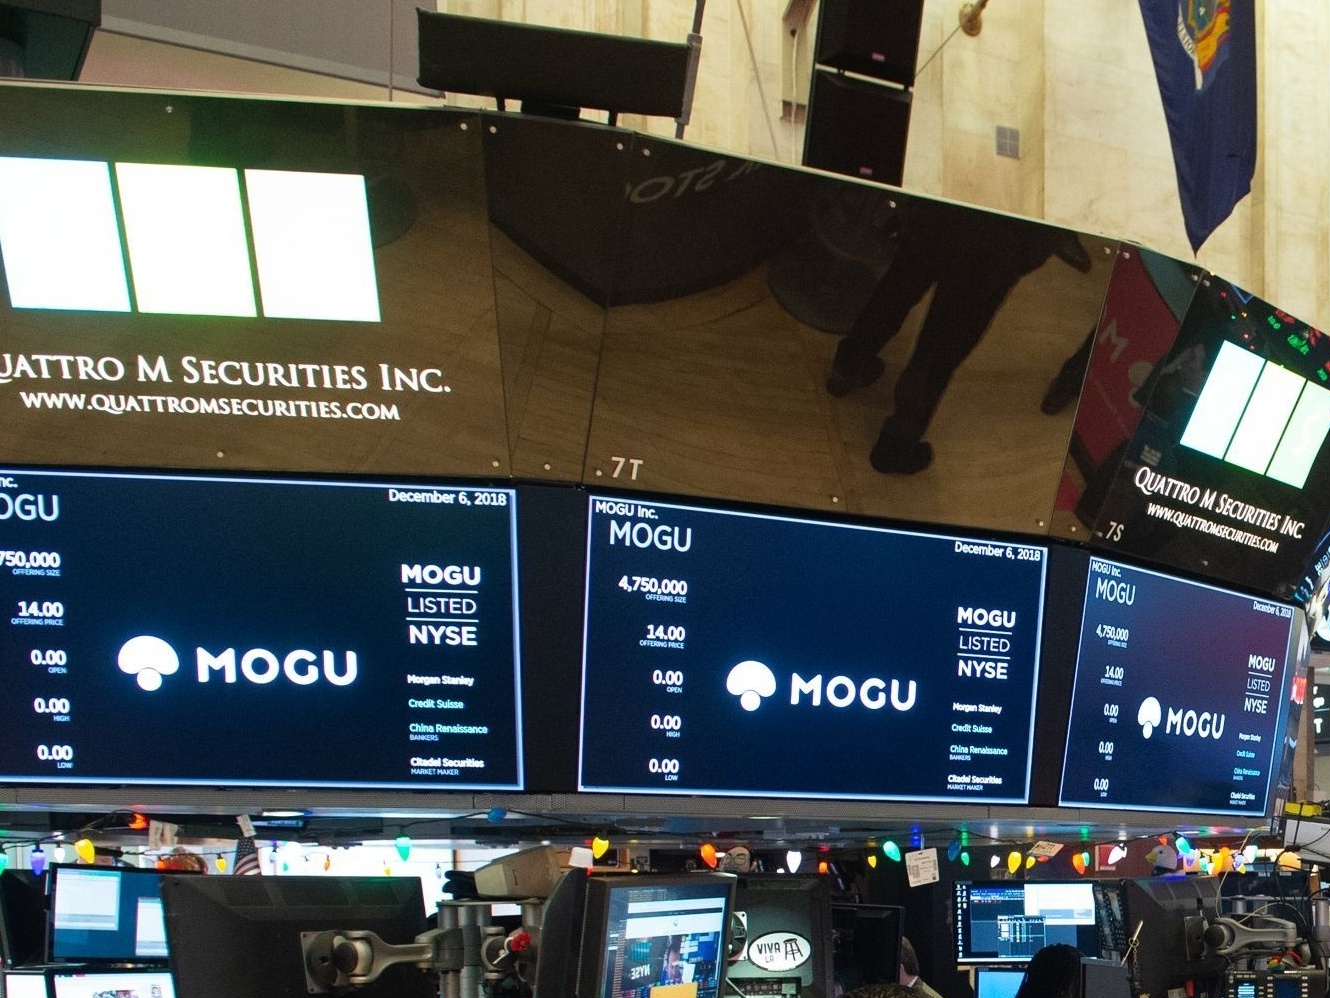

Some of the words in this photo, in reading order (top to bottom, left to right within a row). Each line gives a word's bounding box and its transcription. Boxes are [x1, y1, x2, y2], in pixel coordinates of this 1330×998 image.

[0, 353, 125, 384] UATTRO
[136, 354, 173, 383] M
[19, 391, 401, 421] WWW.QUATTROMSECURITIES.COM
[611, 456, 644, 481] 7T
[0, 477, 18, 488] nc.
[1134, 466, 1201, 505] QUATTRO
[1199, 488, 1218, 511] M
[0, 492, 59, 521] OGU
[388, 489, 456, 504] December
[458, 491, 471, 506] 6,
[474, 492, 507, 507] 2018
[595, 500, 634, 517] MOGU
[637, 505, 658, 519] Inc.
[609, 519, 692, 552] MOGU
[1106, 521, 1124, 541] 7S
[0, 551, 61, 568] 750,000
[954, 541, 1004, 558] December
[1005, 547, 1015, 560] 6,
[1017, 548, 1041, 561] 2018
[12, 568, 45, 576] OFFERING
[401, 563, 481, 586] MOGU
[1091, 560, 1111, 575] MOGU
[618, 575, 688, 595] 4,750,000
[1095, 577, 1136, 605] MOGU
[18, 601, 64, 617] 14.00
[407, 597, 477, 614] LISTED
[957, 606, 1016, 628] MOGU
[409, 624, 478, 646] NYSE
[646, 624, 686, 641] 14.00
[1096, 624, 1129, 641] 4,750,000
[959, 635, 1010, 652] LISTED
[31, 649, 67, 665] 0.00
[1248, 653, 1276, 672] MOGU
[196, 647, 358, 687] MOGU
[957, 659, 1009, 680] NYSE
[1104, 665, 1124, 680] 14.00
[407, 674, 441, 686] Morgan
[652, 669, 684, 686] 0.00
[1246, 677, 1270, 692] LISTED
[790, 672, 917, 711] MOGU
[34, 698, 70, 713] 0.00
[408, 698, 435, 708] Credit
[436, 699, 464, 709] Suisse
[1103, 703, 1119, 717] 0.00
[1244, 697, 1268, 714] NYSE
[409, 723, 434, 733] China
[435, 723, 488, 734] Renaissance
[651, 714, 682, 730] 0.00
[951, 723, 971, 733] Credit
[1165, 706, 1226, 740] MOGU
[37, 745, 73, 761] 0.00
[950, 745, 968, 754] China
[1099, 741, 1114, 755] 0.00
[649, 758, 679, 774] 0.00
[1094, 777, 1109, 791] 0.00
[756, 942, 781, 955] VIVA
